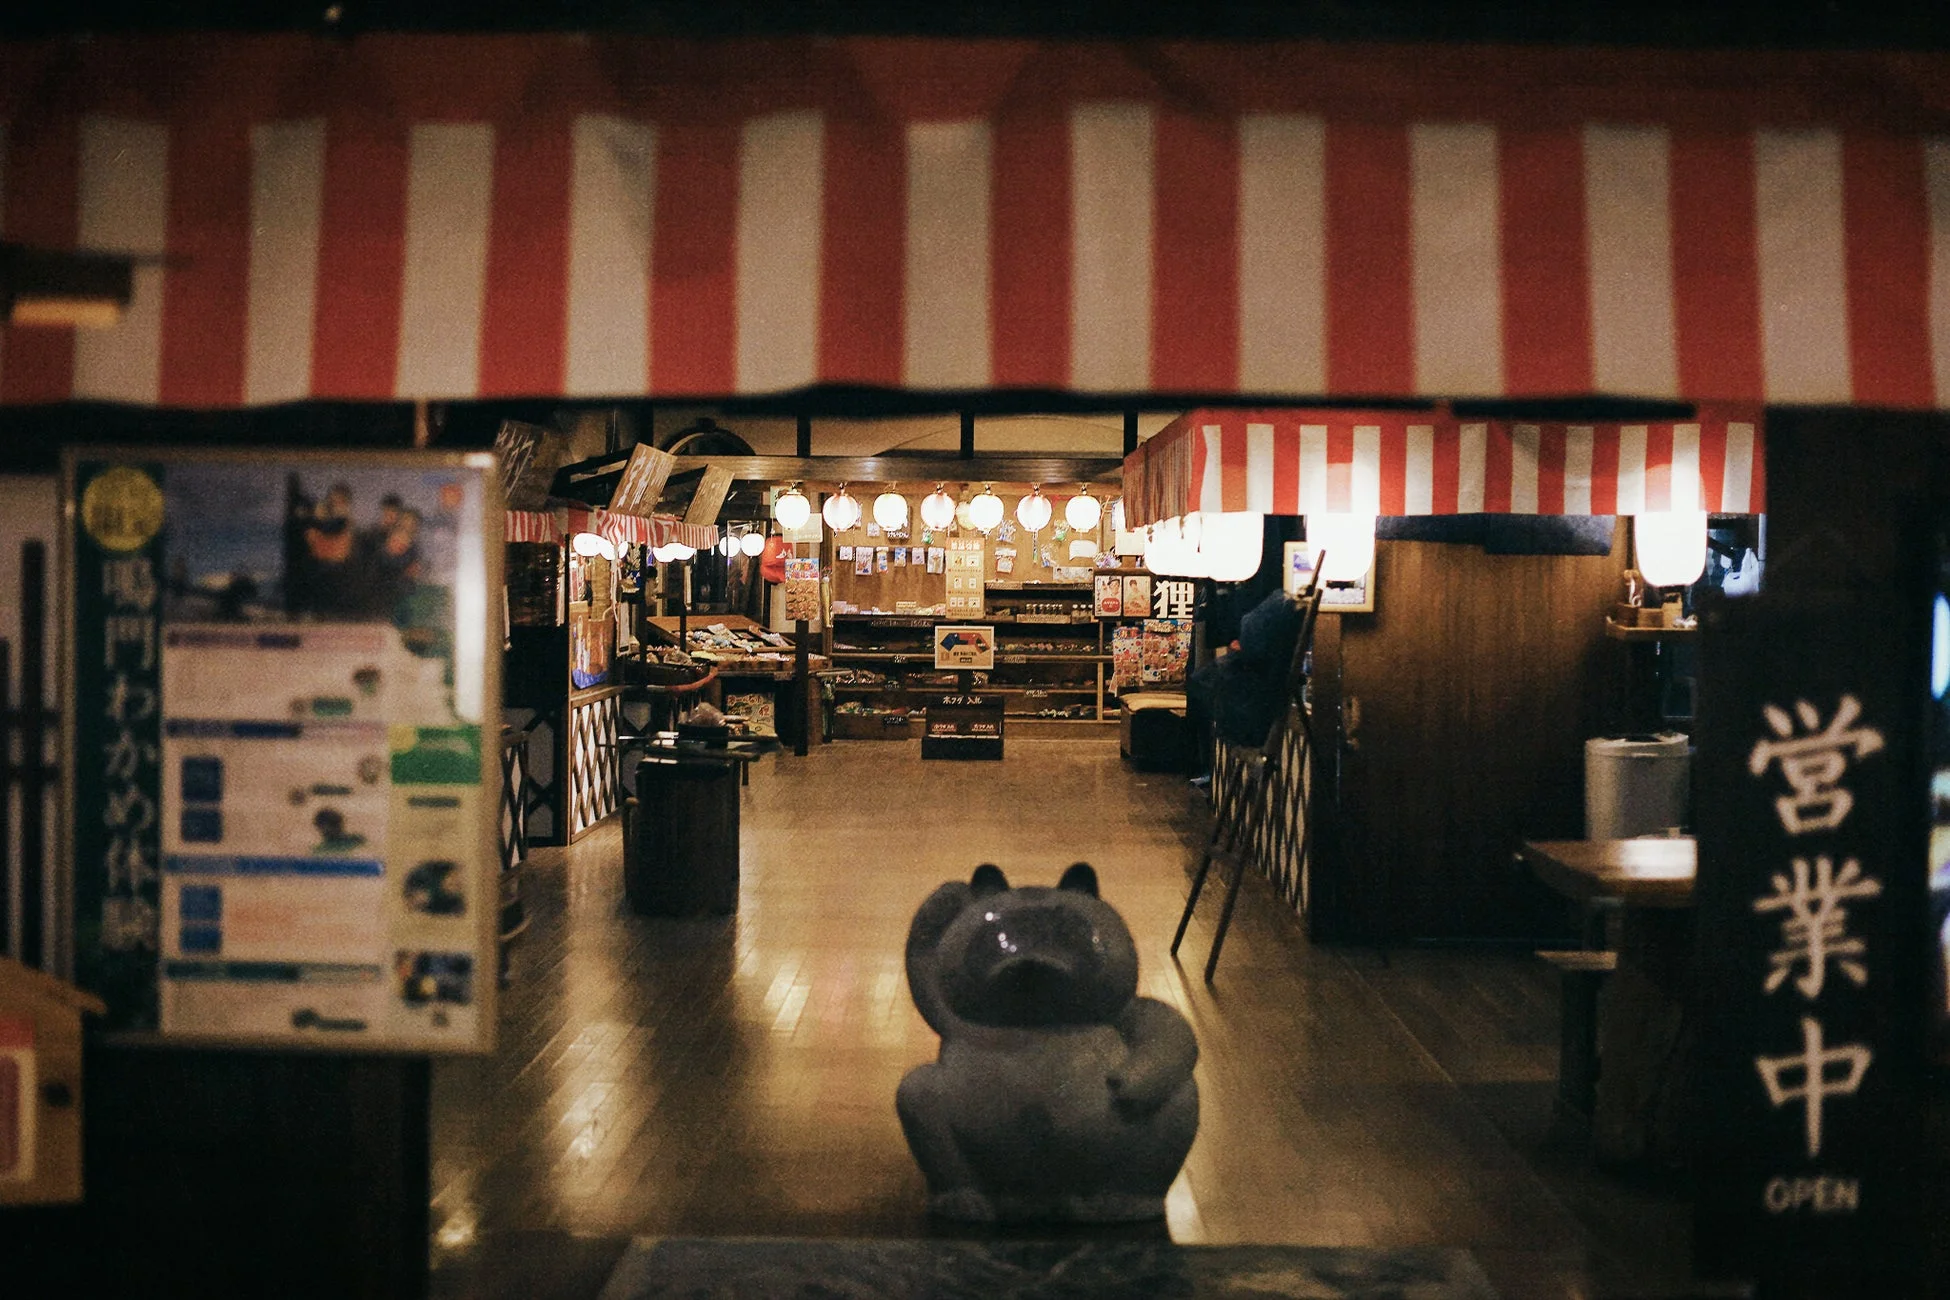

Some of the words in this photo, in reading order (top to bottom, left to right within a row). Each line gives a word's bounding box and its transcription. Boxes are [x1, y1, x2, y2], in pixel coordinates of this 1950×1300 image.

[1153, 579, 1195, 619] 狸
[1749, 694, 1884, 1157] 営業中
[1764, 1177, 1859, 1212] OPEN
